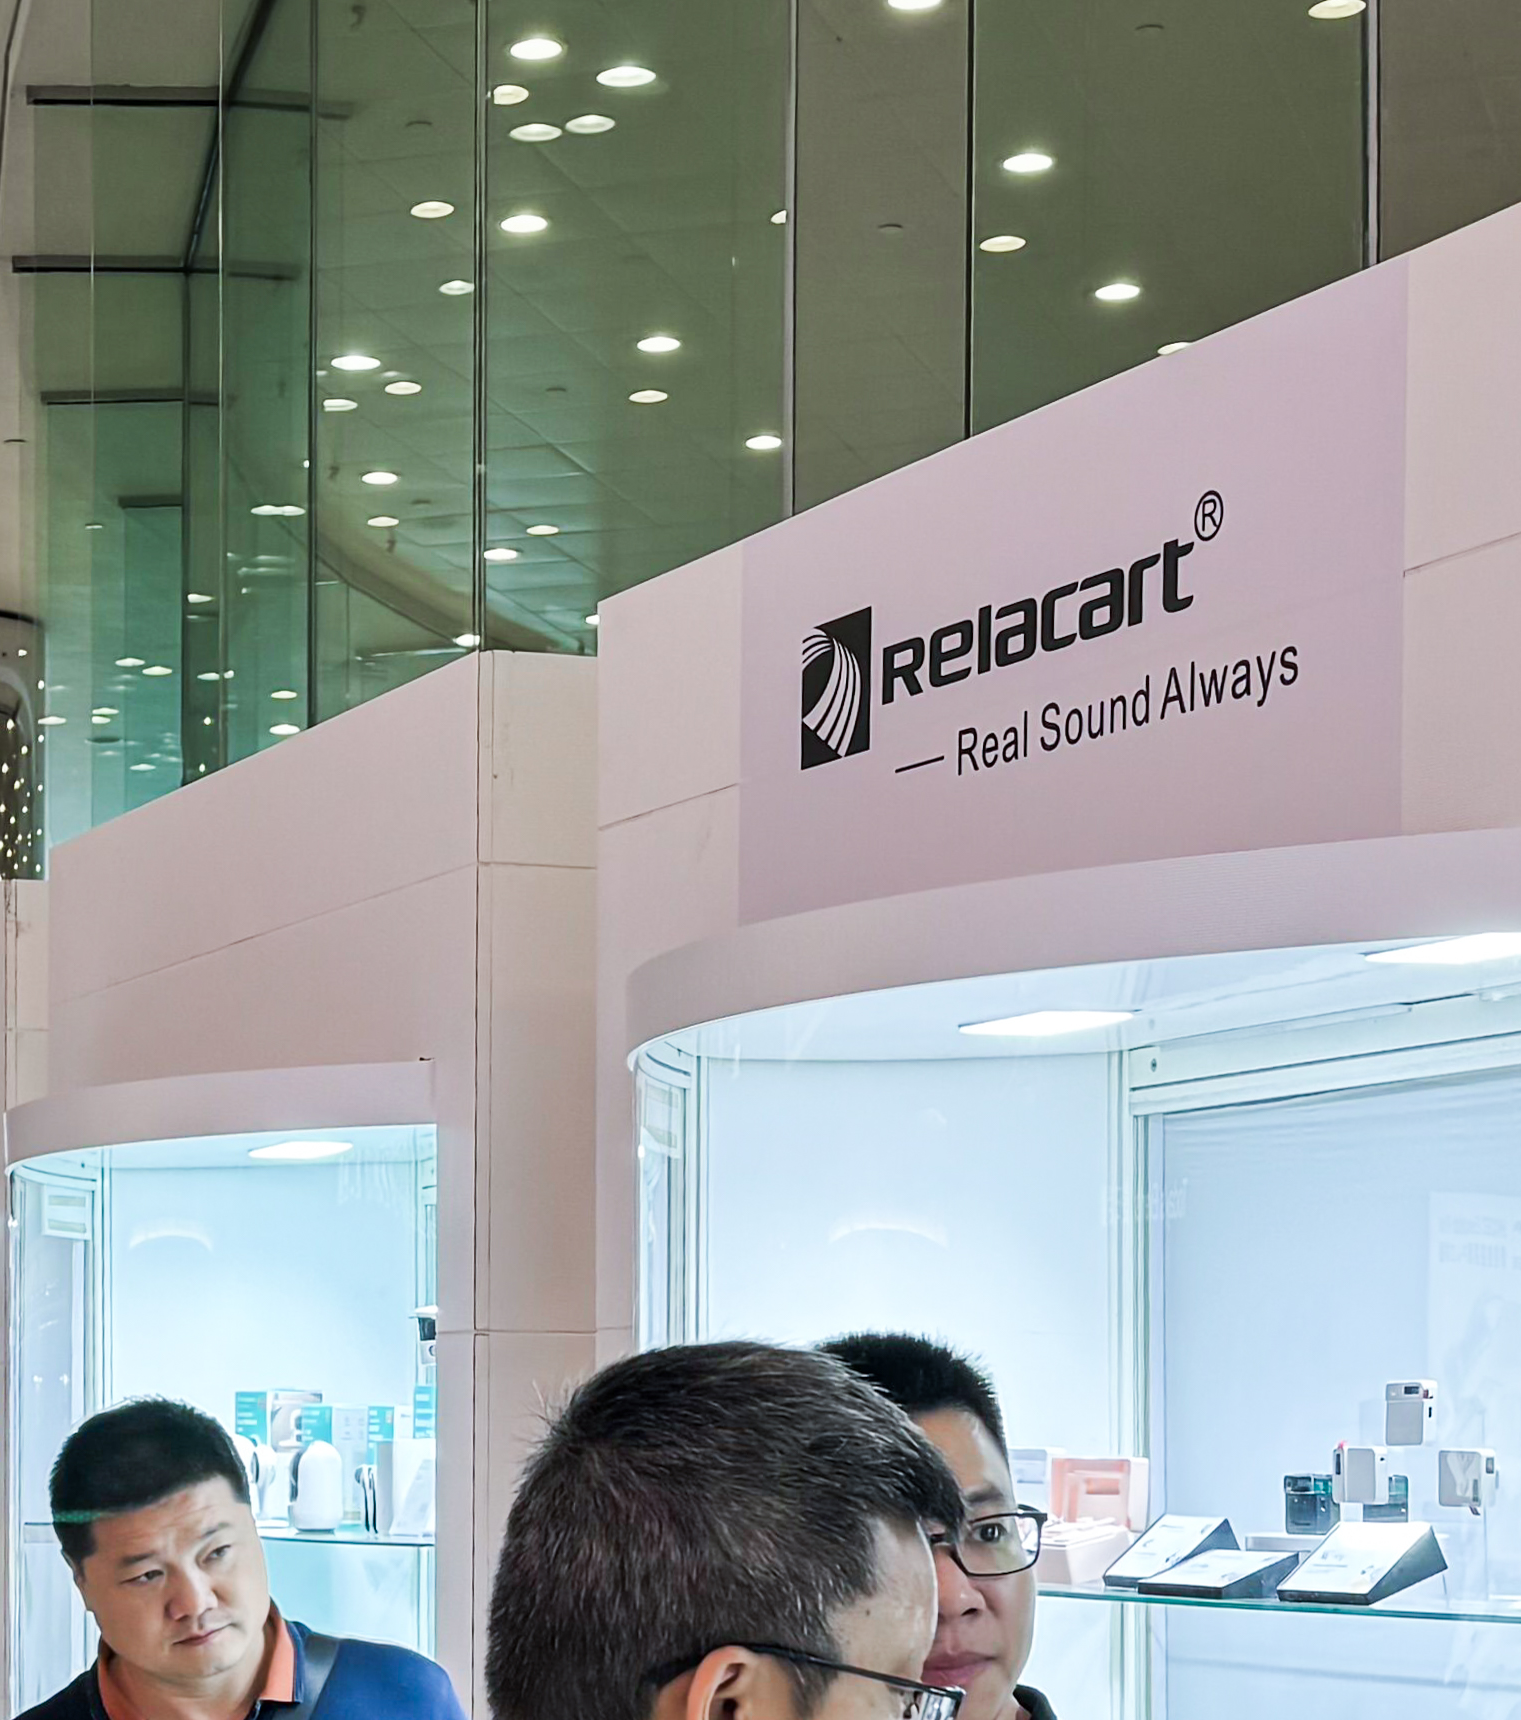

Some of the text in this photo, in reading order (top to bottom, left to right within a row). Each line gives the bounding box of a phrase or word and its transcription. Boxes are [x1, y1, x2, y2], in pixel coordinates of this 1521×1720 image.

[957, 645, 1300, 775] Real Sound Always
